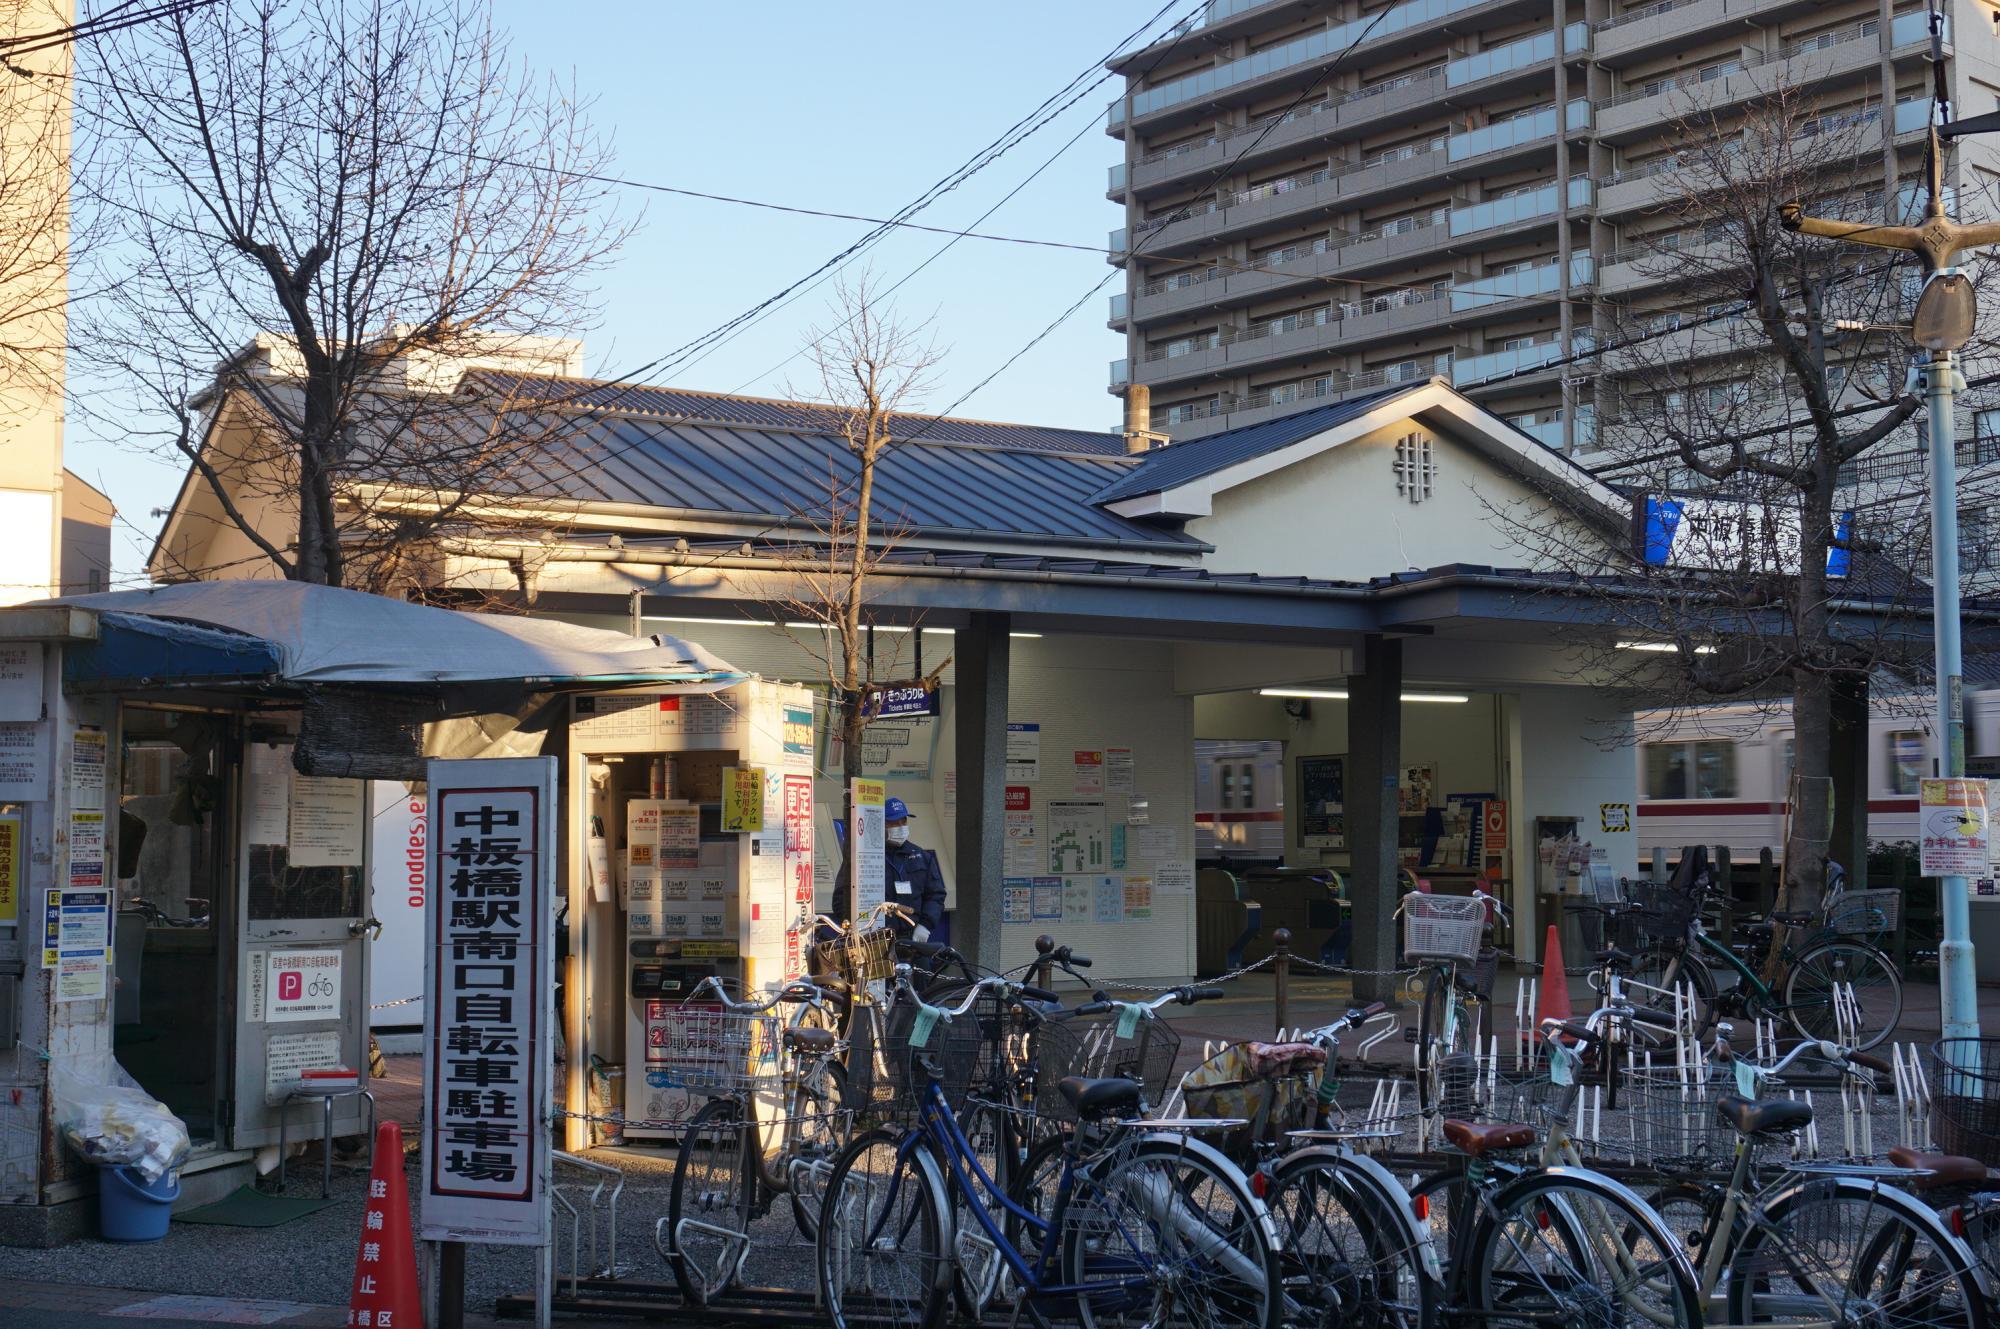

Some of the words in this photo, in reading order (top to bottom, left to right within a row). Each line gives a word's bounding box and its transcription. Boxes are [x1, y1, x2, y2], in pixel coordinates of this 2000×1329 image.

[742, 771, 750, 816] 定期利用者
[750, 772, 759, 824] 駐輪ラックは
[1489, 803, 1503, 811] AED
[1923, 836, 1987, 849] カギは二重に
[285, 975, 297, 998] P
[445, 805, 524, 1184] 中板橋駅南口自転車駐車場
[360, 1179, 387, 1295] 駐輪禁止
